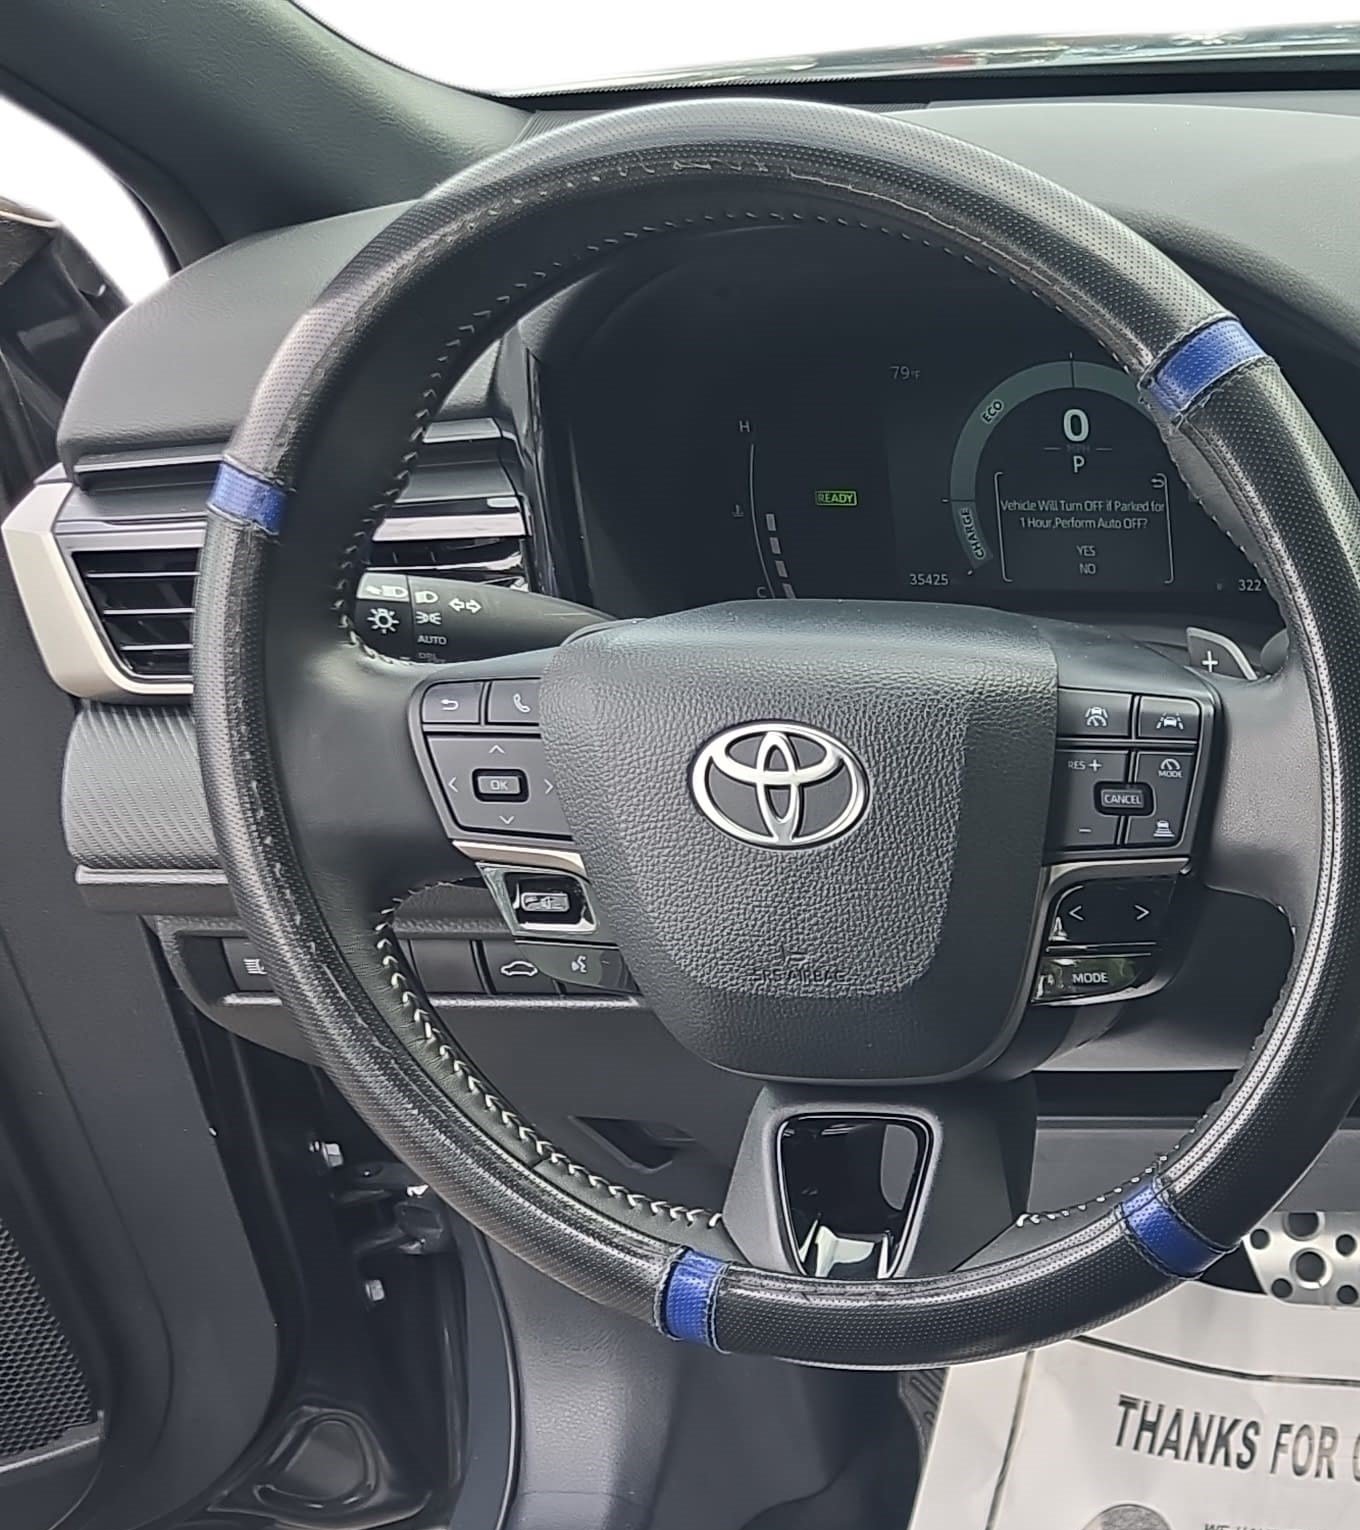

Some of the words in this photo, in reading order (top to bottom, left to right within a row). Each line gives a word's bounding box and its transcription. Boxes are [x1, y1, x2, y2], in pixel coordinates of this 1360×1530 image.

[982, 401, 1002, 421] ECO
[739, 420, 750, 432] H
[1064, 409, 1089, 441] 0
[1073, 455, 1085, 472] P
[817, 494, 853, 503] READY
[1001, 501, 1036, 511] Vehicle
[1038, 501, 1058, 511] Will
[1060, 501, 1083, 512] Turn
[1084, 501, 1104, 512] OFF
[1106, 501, 1113, 512] if
[1115, 501, 1149, 512] Parked
[1151, 501, 1165, 512] for
[1020, 517, 1025, 528] 1
[1097, 518, 1122, 529] Auto
[1123, 518, 1148, 529] OFF?
[959, 507, 985, 559] CHARGE
[1076, 545, 1096, 557] YES
[1079, 563, 1096, 575] NO
[909, 573, 949, 586] 35425
[1238, 579, 1262, 592] 322
[417, 634, 447, 645] AUTO
[1068, 760, 1086, 770] RES
[1158, 770, 1183, 778] MODE
[490, 780, 509, 791] OK
[1104, 794, 1142, 805] CANCEL
[1071, 972, 1109, 984] MODE
[1113, 1394, 1262, 1470] THANKS
[1270, 1423, 1338, 1480] FOR
